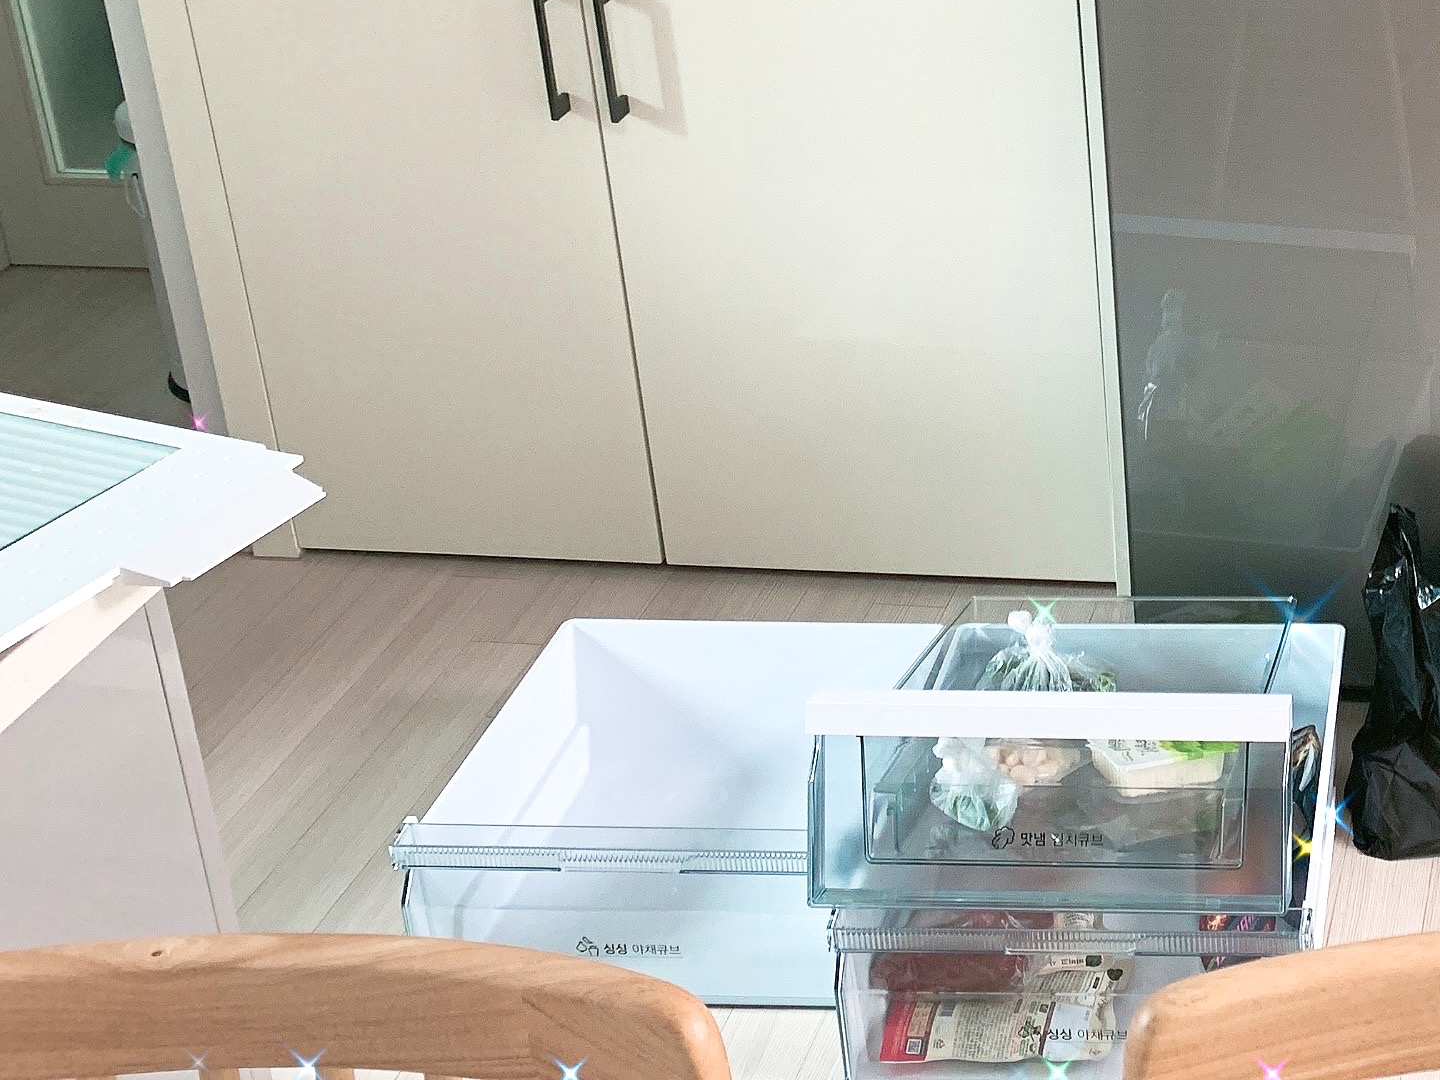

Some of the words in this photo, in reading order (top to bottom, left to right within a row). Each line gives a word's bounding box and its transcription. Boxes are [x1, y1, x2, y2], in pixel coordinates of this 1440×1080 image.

[1020, 831, 1046, 847] 맛냄
[603, 943, 628, 955] 싱싱
[632, 944, 681, 955] 야채큐브
[1048, 1028, 1073, 1041] 싱싱
